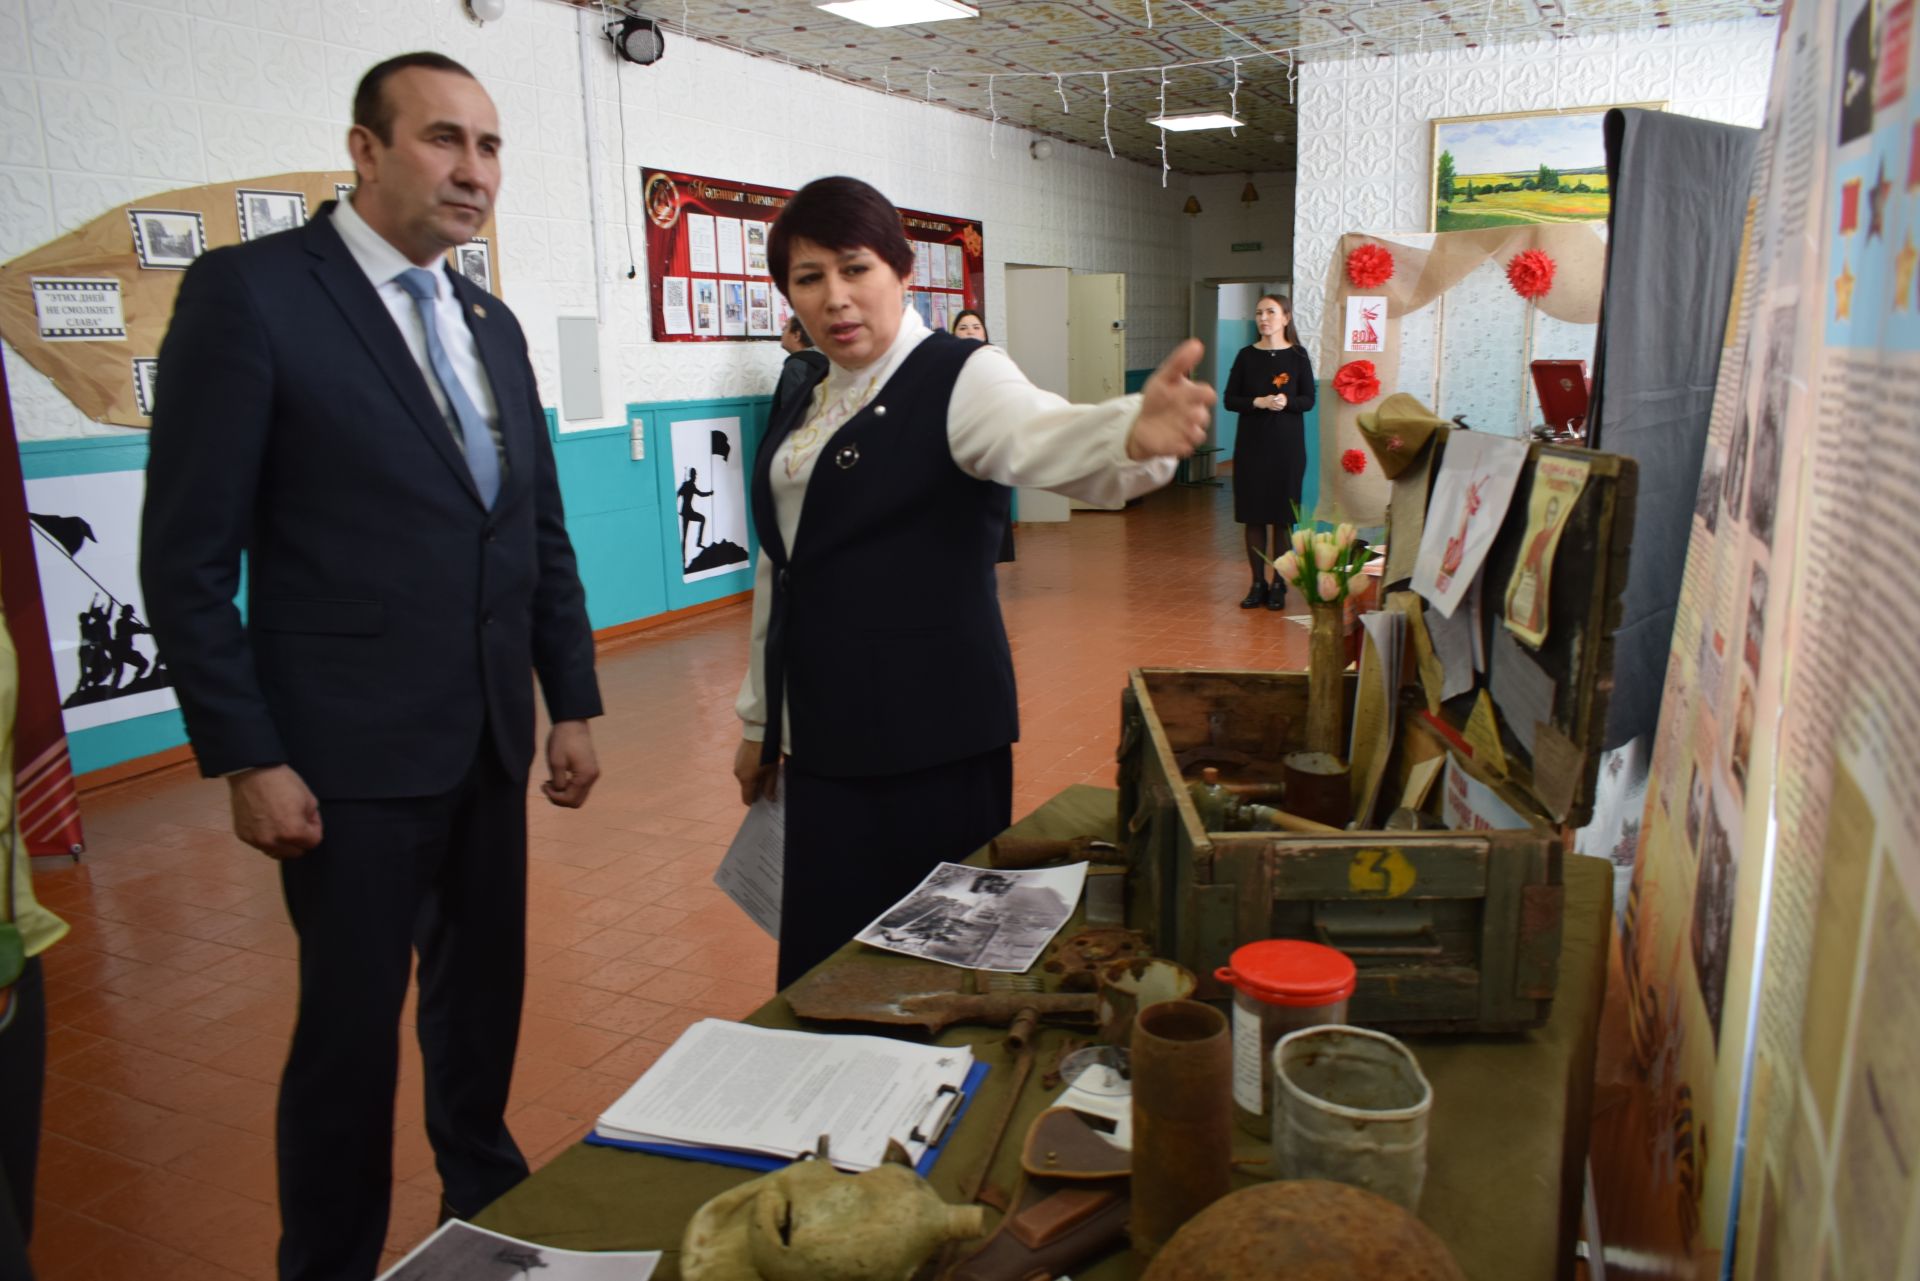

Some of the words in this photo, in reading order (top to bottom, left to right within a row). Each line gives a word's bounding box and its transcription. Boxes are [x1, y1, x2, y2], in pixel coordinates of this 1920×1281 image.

[79, 292, 105, 303] ДНЕЙ
[46, 305, 60, 315] НЕ
[61, 305, 116, 315] СМОЛКНЕТ
